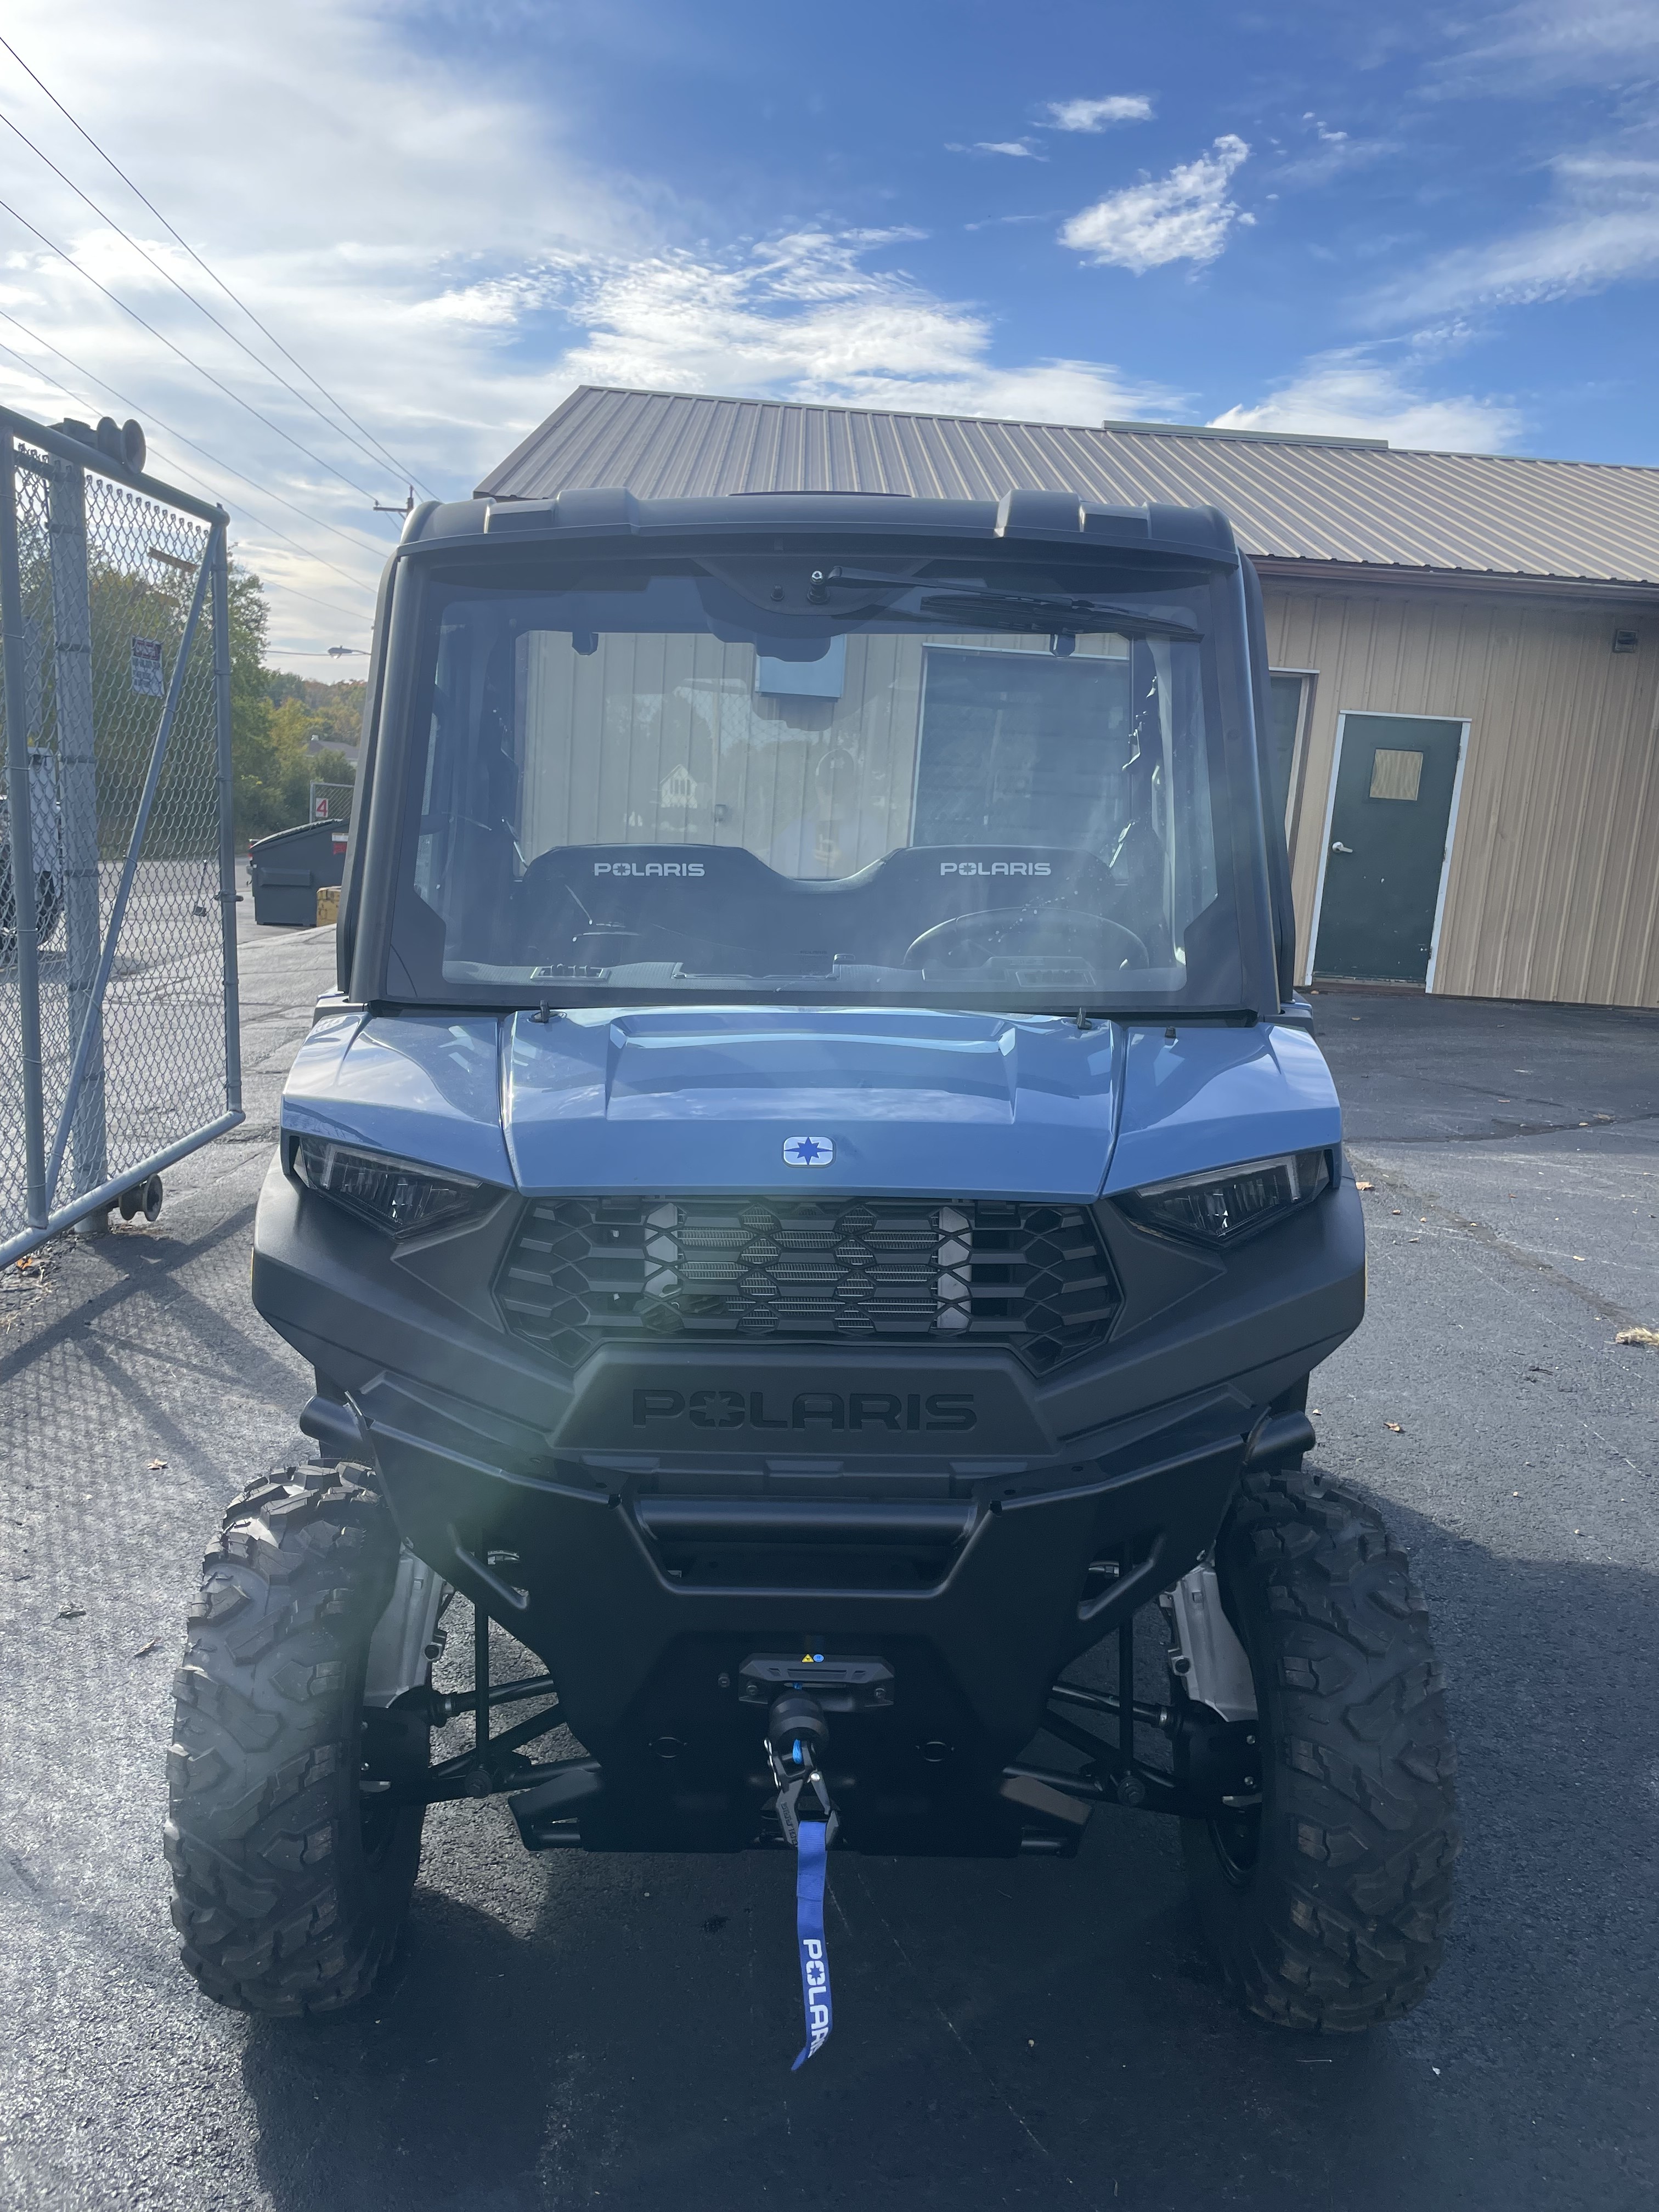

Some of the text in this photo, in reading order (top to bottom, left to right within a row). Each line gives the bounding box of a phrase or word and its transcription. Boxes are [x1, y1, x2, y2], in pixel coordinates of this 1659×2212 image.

[317, 799, 328, 816] 4
[594, 863, 705, 877] POLARIS
[940, 862, 1051, 876] POLARIS
[633, 1389, 978, 1432] POLARIS
